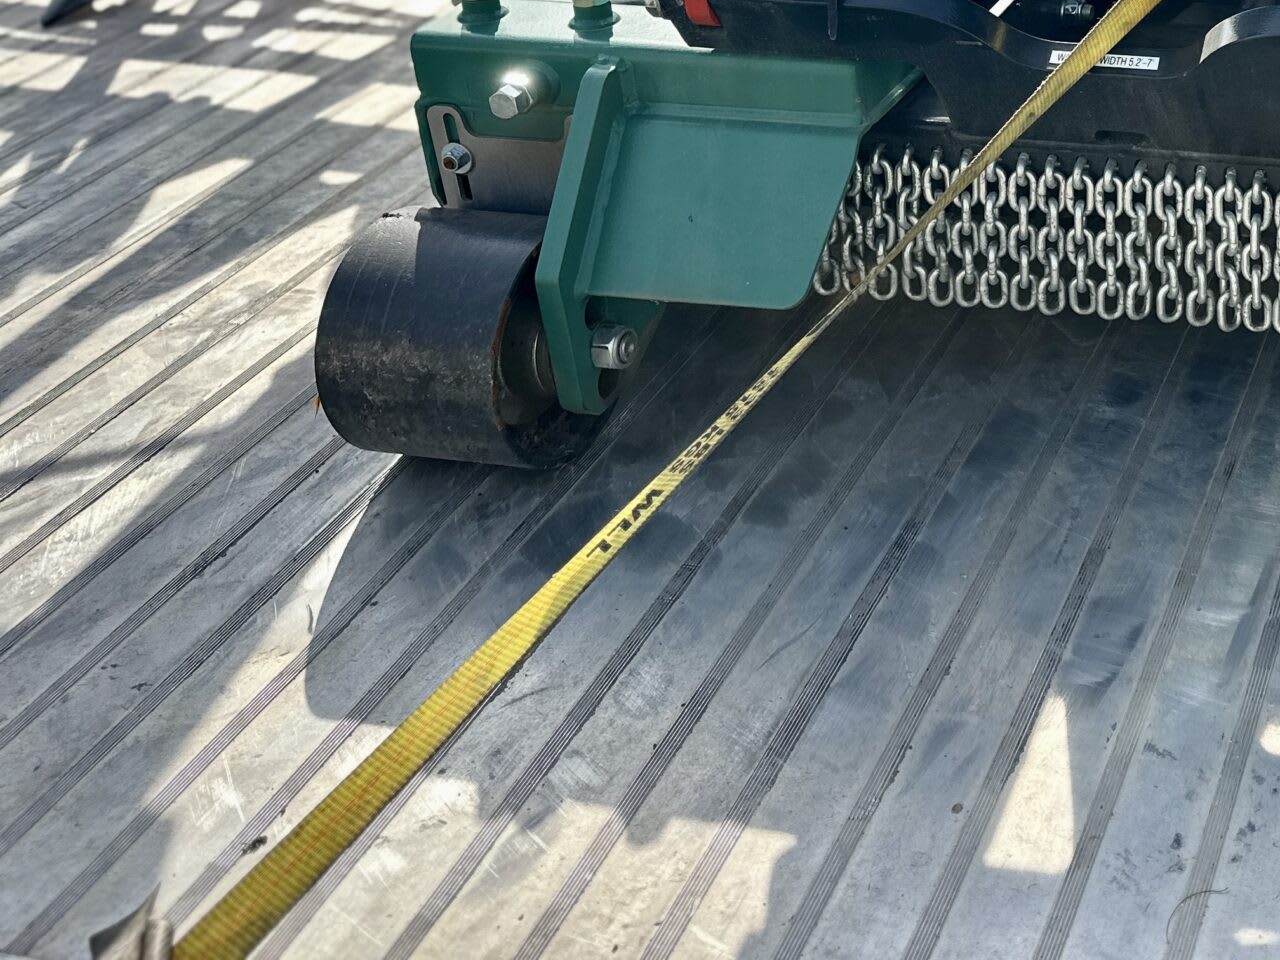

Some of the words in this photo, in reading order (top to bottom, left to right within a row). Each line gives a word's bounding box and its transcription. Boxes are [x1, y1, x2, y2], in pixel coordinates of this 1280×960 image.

[1100, 56, 1128, 66] WIDTH
[669, 425, 720, 474] KGS
[586, 490, 665, 558] WLL
